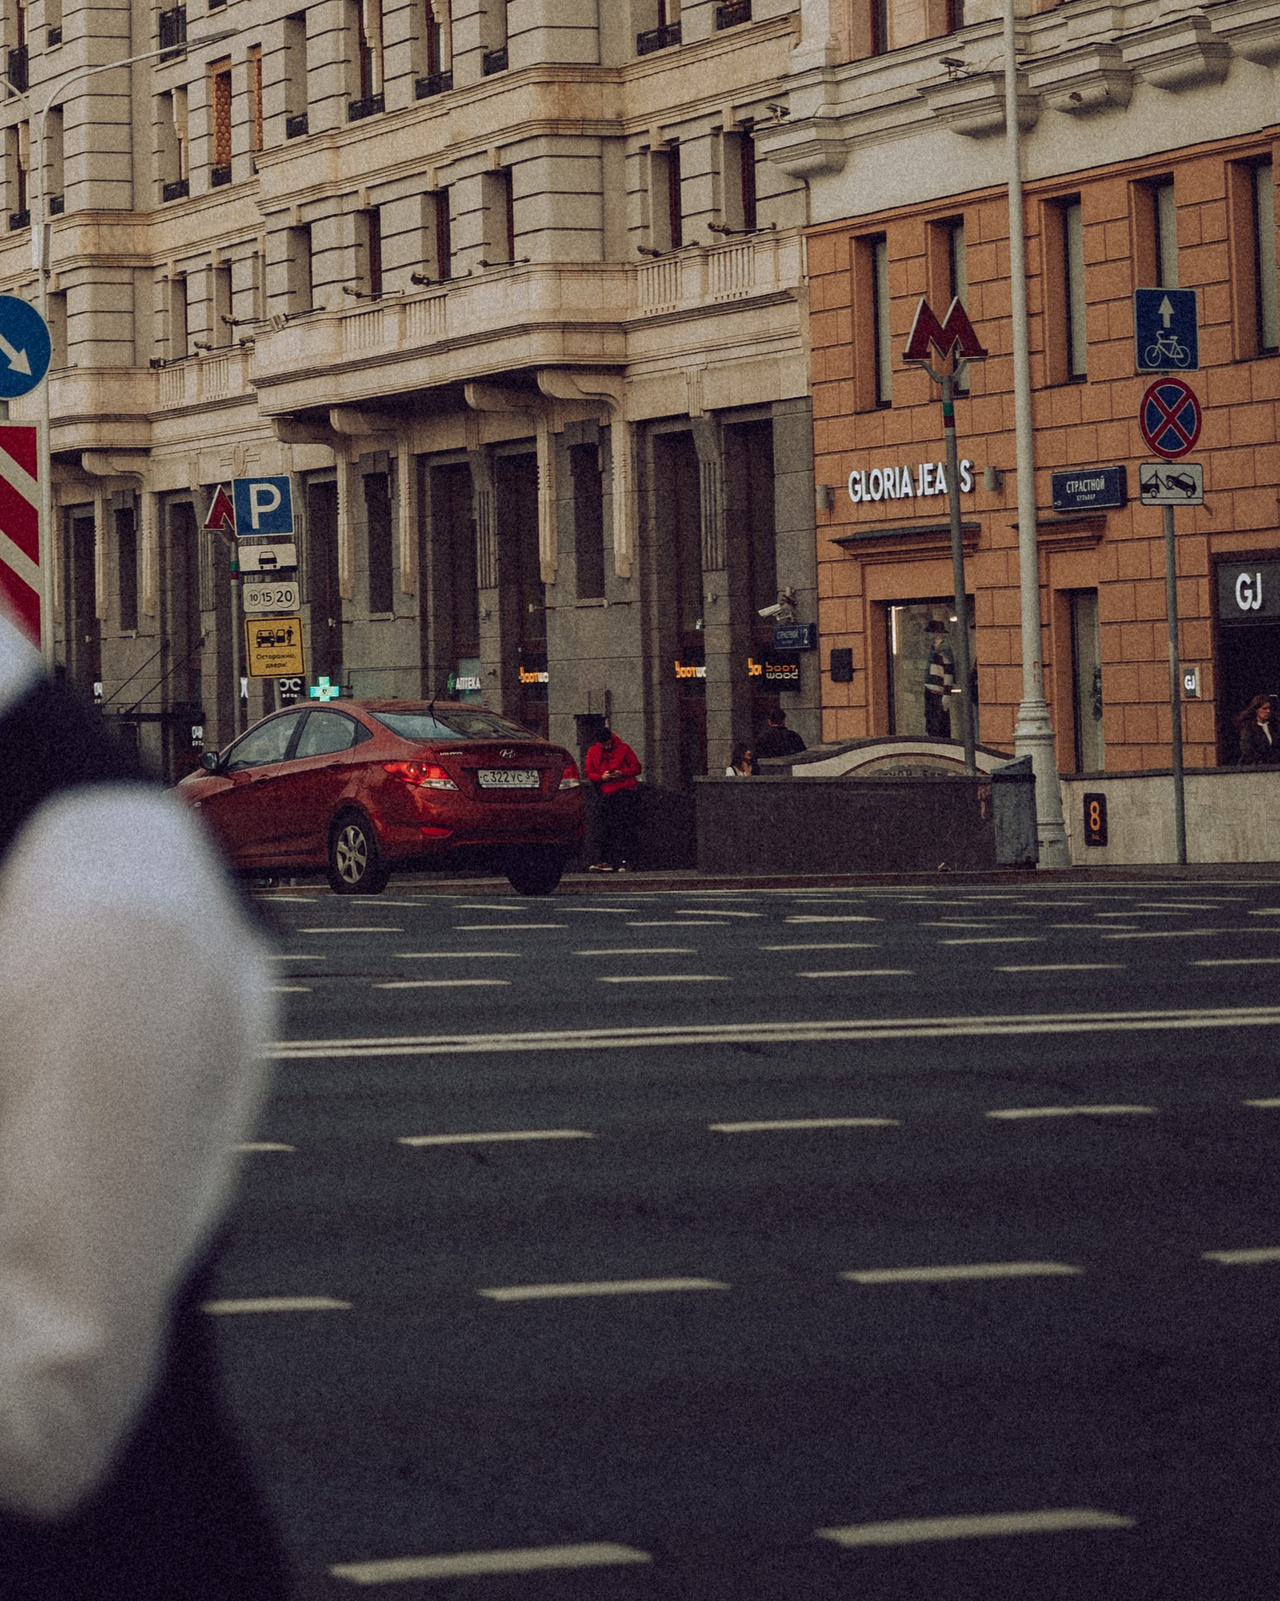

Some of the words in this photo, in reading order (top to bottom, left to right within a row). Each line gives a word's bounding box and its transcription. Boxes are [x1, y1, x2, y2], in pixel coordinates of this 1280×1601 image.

[848, 465, 914, 502] GLORIA
[916, 459, 973, 497] JEAS
[1066, 475, 1105, 493] СТРАСТНОЙ
[249, 483, 281, 529] P
[249, 593, 259, 602] 10
[261, 591, 273, 603] 15
[276, 590, 293, 603] 20
[1235, 572, 1262, 610] GJ
[802, 628, 809, 644] 2
[455, 677, 481, 690] АПТЕКА
[1184, 675, 1196, 690] GJ
[1090, 800, 1100, 831] 8
